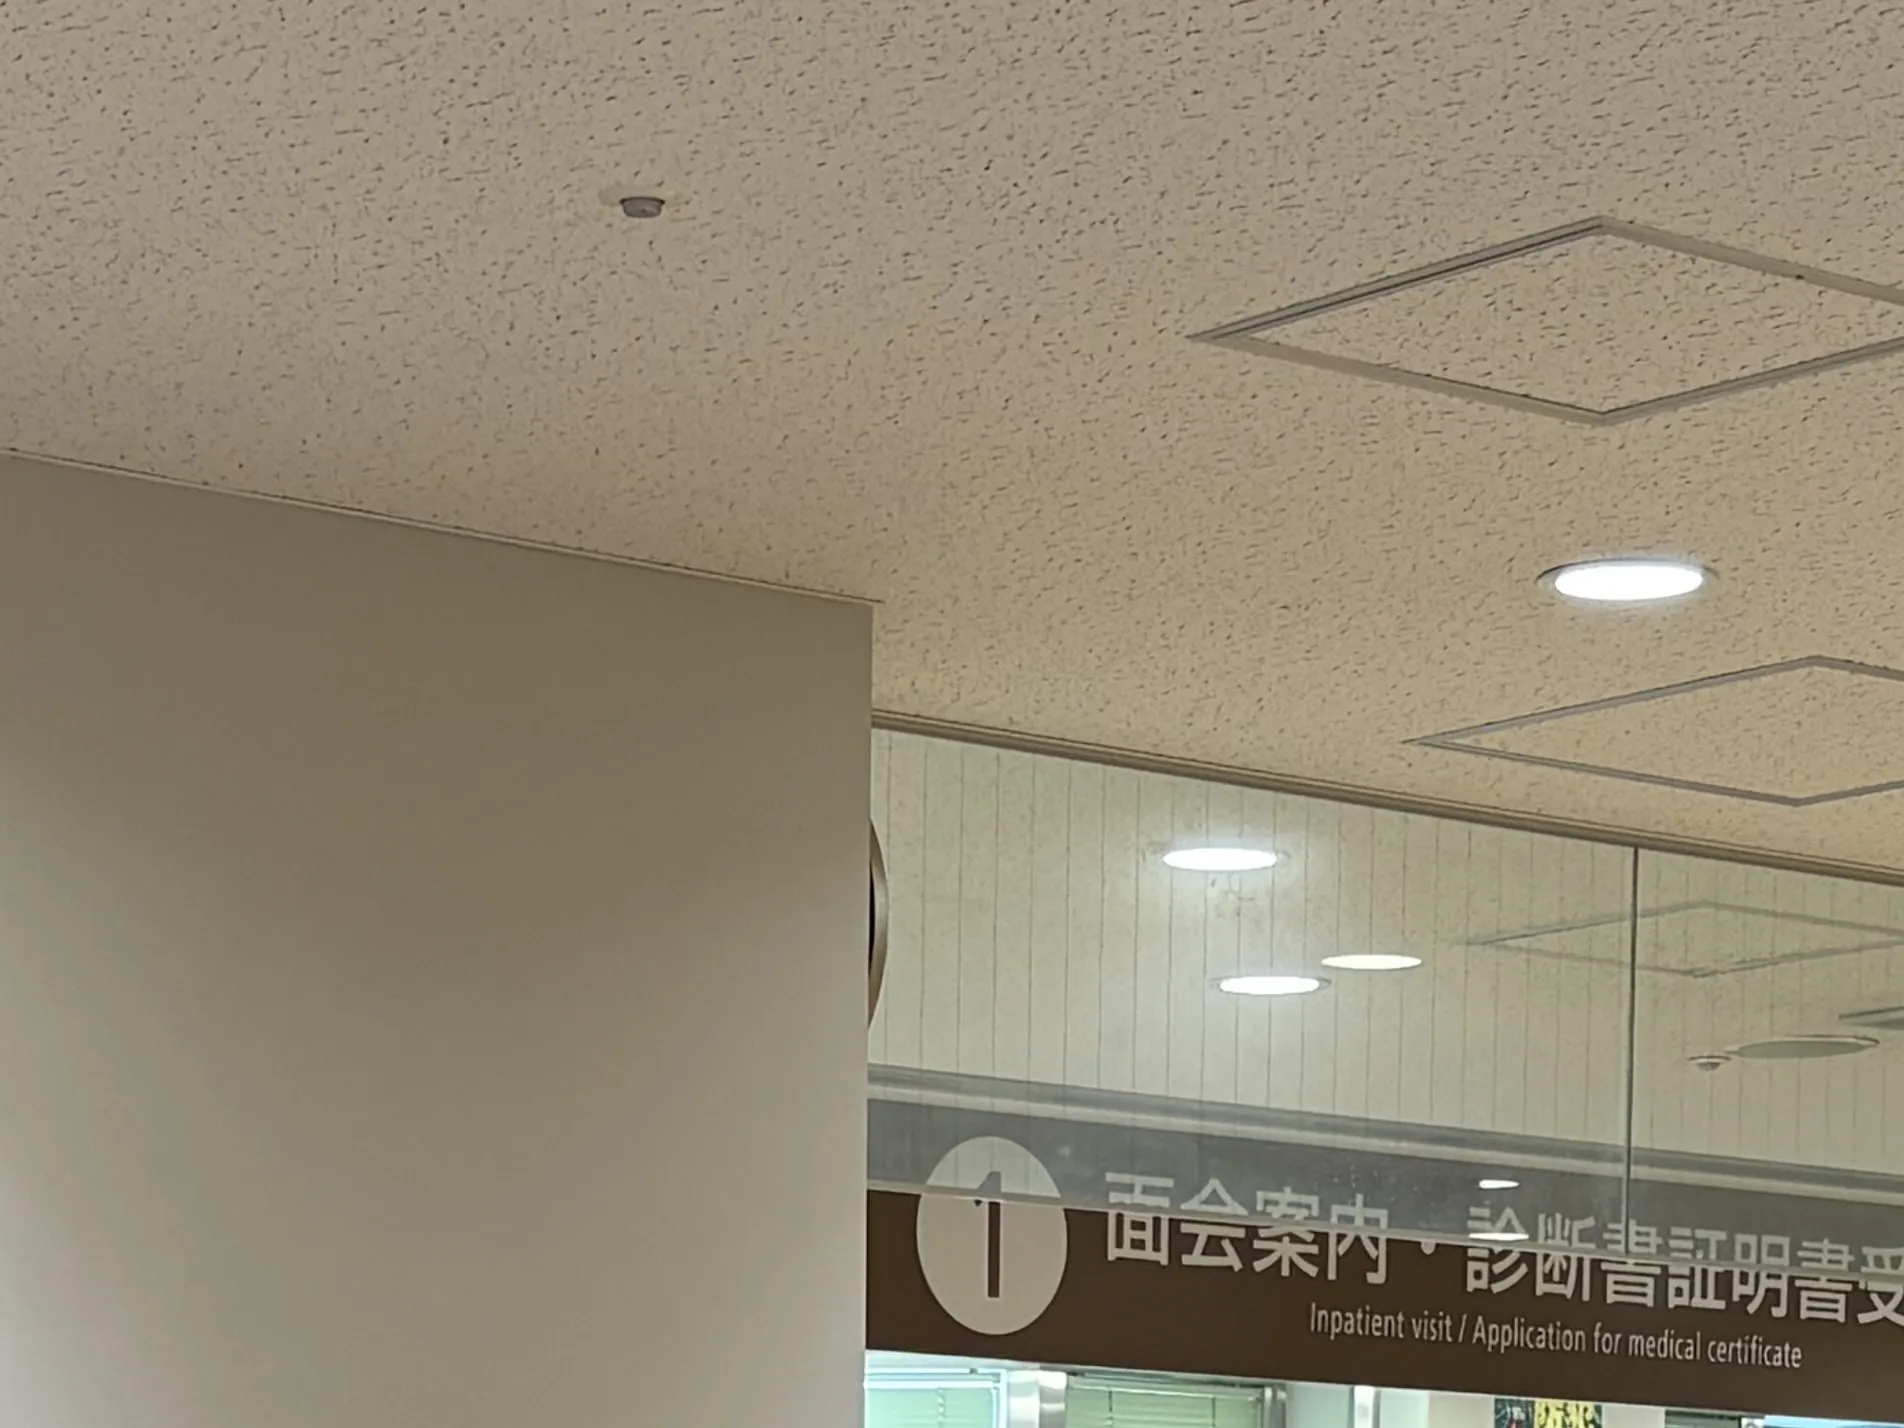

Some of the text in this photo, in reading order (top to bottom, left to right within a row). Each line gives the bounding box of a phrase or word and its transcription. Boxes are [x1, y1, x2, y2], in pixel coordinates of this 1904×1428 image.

[974, 1171, 1002, 1298] 1
[1309, 1302, 1405, 1339] Inpatient
[1412, 1308, 1452, 1343] visit
[1472, 1315, 1587, 1355] Application
[1593, 1322, 1622, 1355] for
[1628, 1327, 1701, 1361] medical
[1707, 1336, 1803, 1369] certificate
